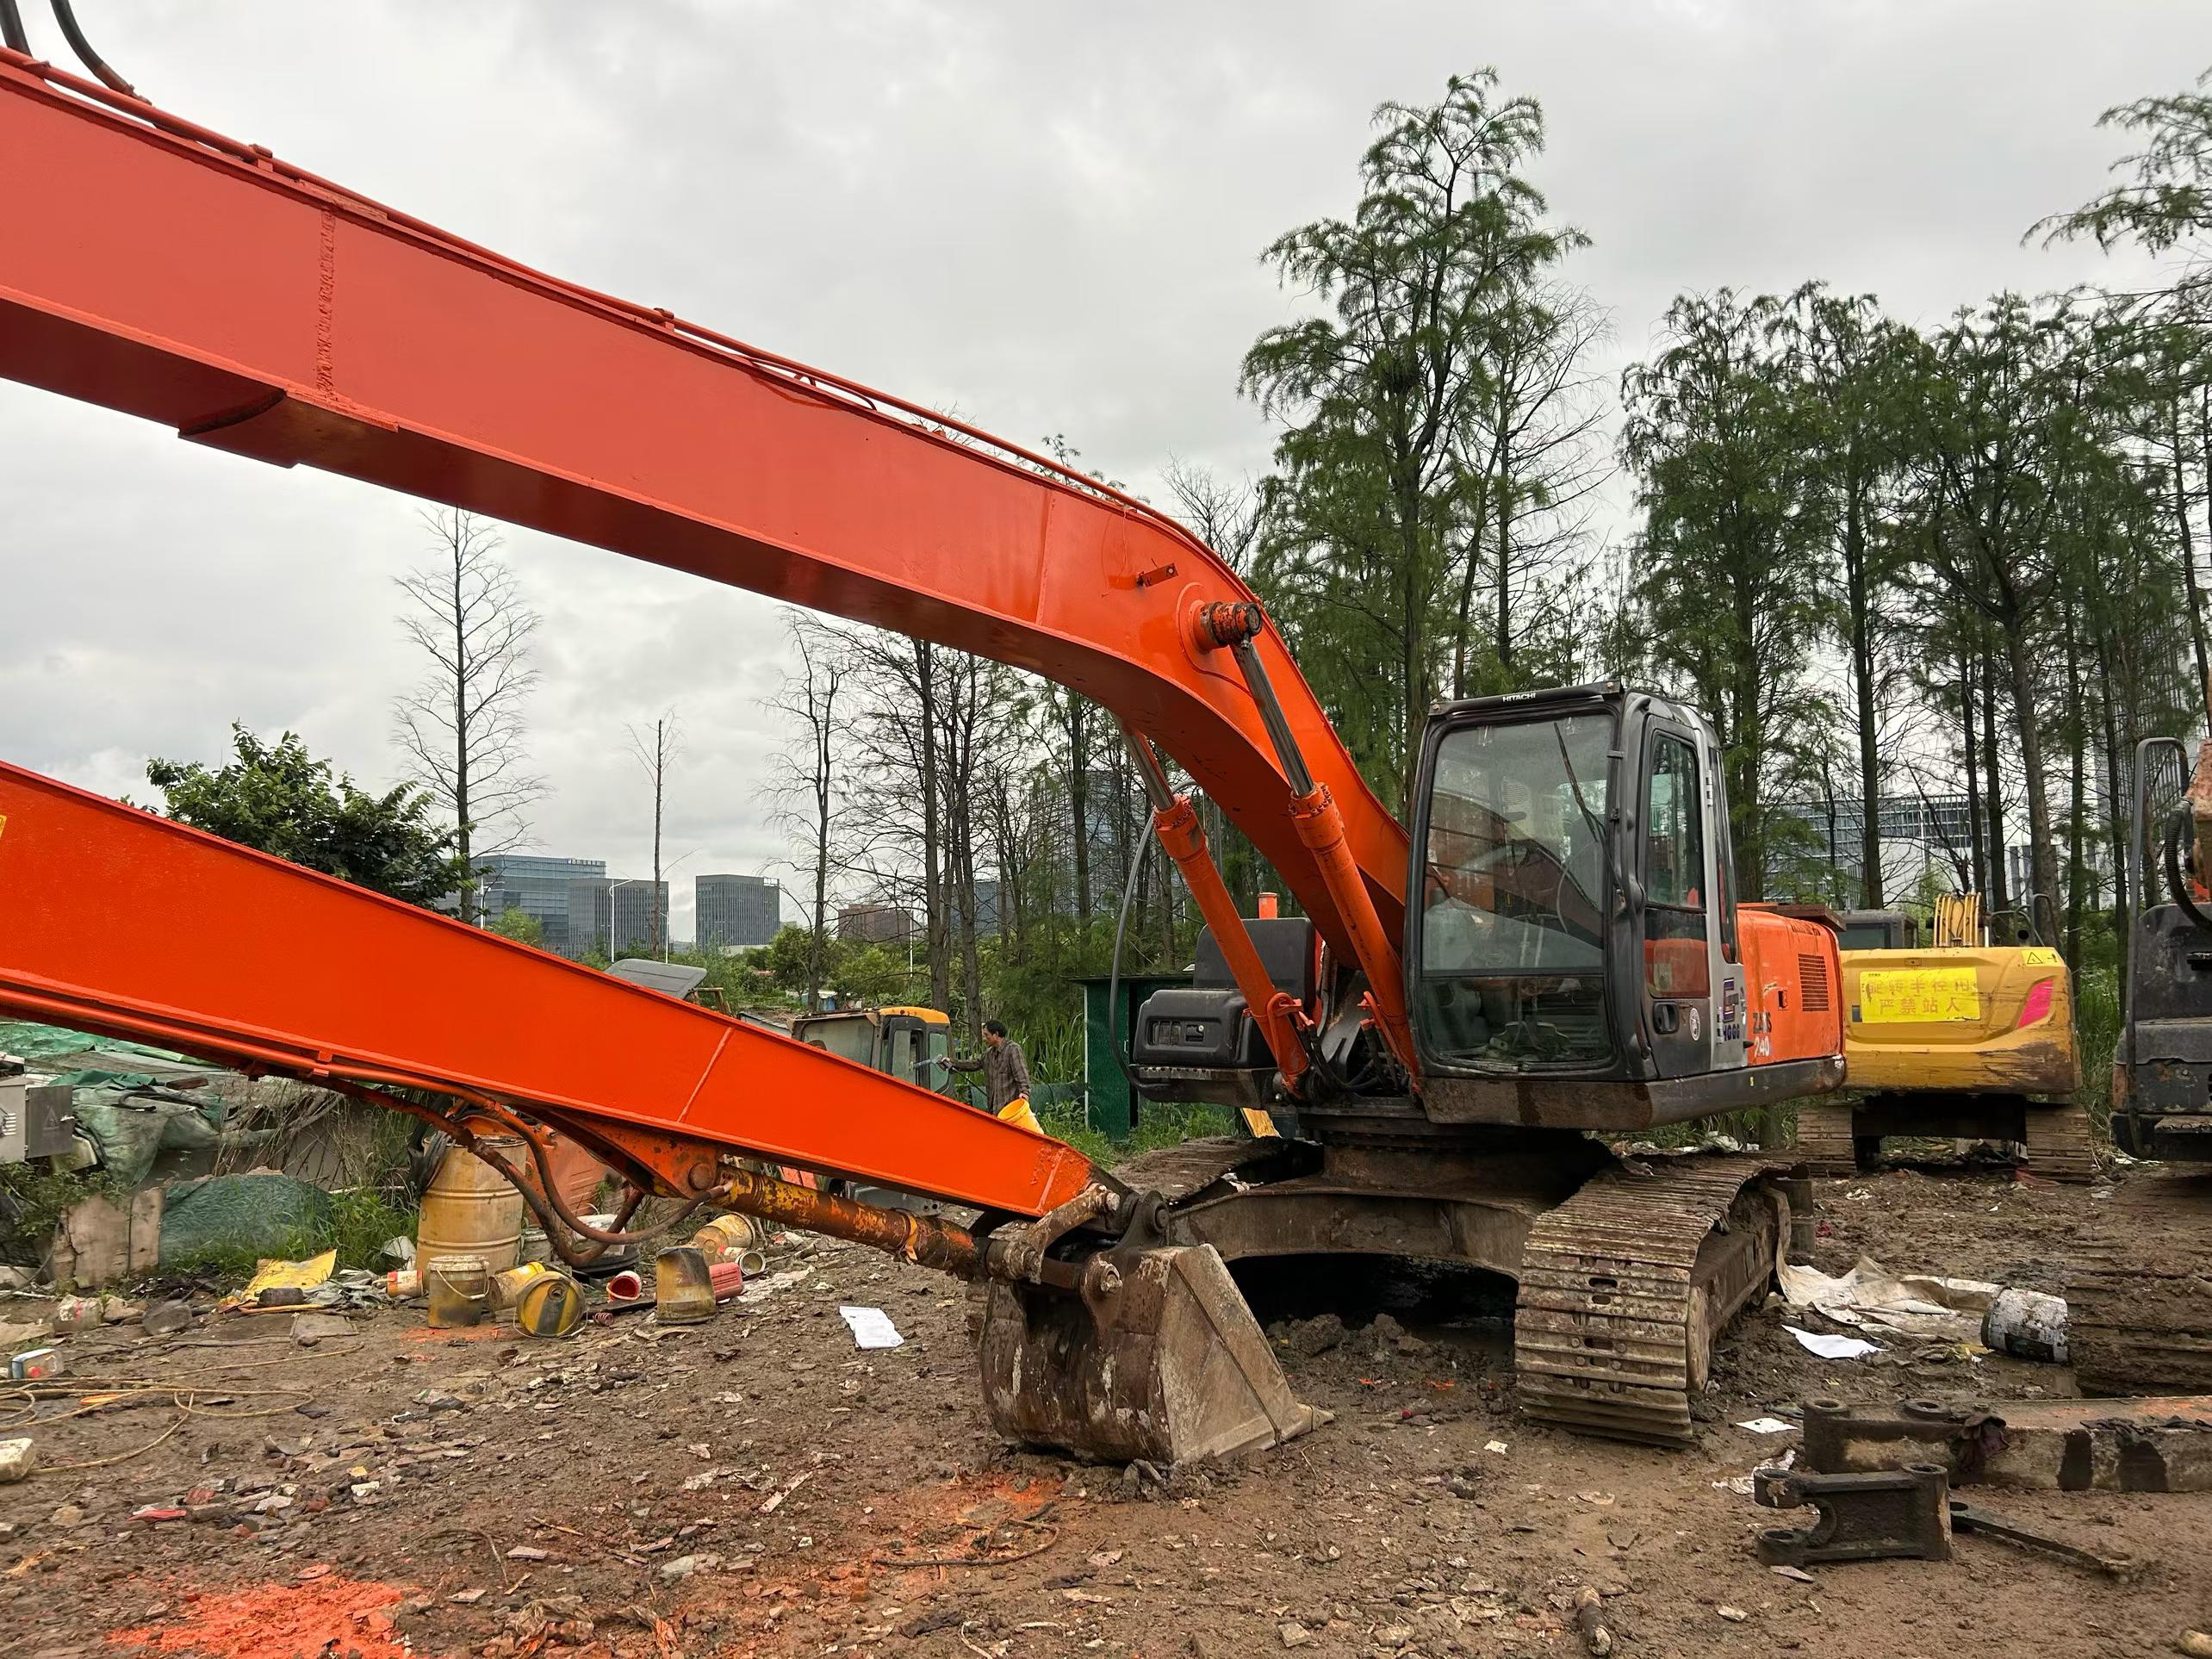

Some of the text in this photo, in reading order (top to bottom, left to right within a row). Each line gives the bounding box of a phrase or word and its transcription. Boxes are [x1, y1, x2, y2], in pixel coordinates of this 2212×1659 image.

[1502, 693, 1536, 702] HITACHI
[1880, 997, 1960, 1015] 严禁站人
[1754, 1035, 1770, 1058] 240
